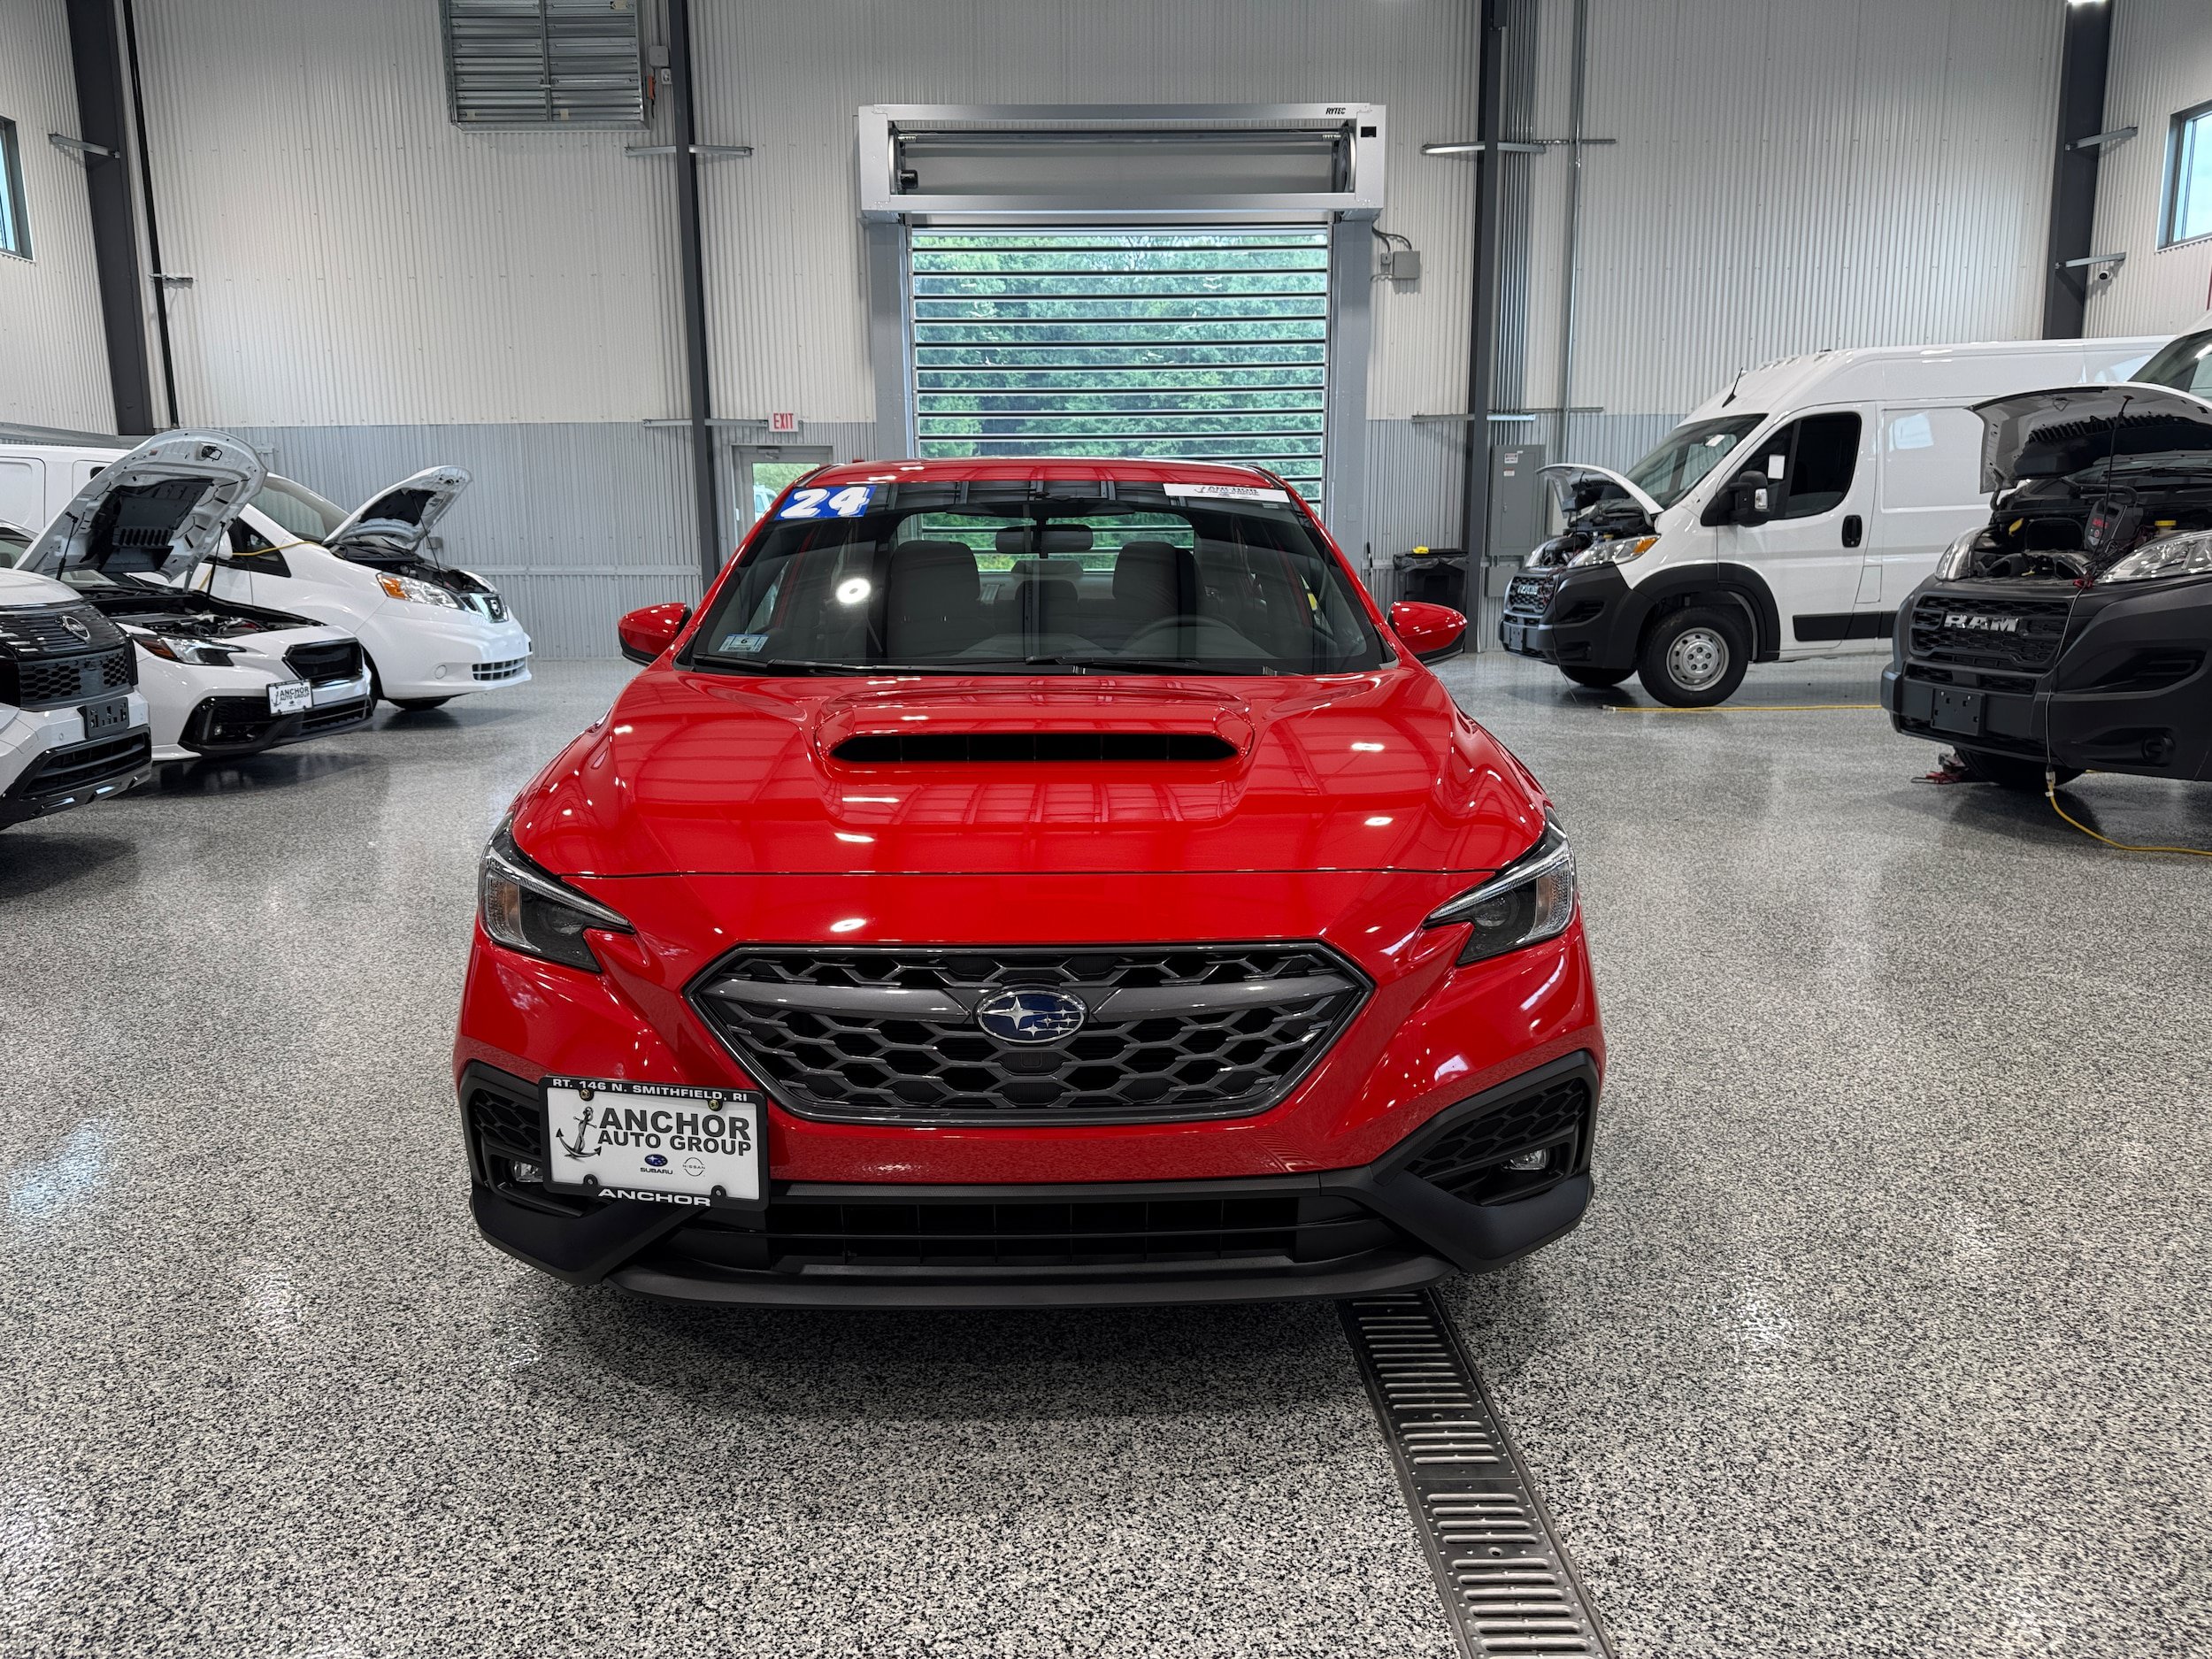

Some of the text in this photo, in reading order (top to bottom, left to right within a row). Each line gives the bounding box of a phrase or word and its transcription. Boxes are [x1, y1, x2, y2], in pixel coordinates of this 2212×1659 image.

[773, 412, 794, 429] EXIT
[780, 487, 870, 518] 24
[1944, 614, 2018, 632] RAM
[280, 686, 310, 696] ANCHOR
[552, 1079, 573, 1087] RT.
[580, 1081, 606, 1090] 146
[611, 1083, 627, 1092] N.
[733, 1093, 748, 1102] RI
[599, 1107, 751, 1141] ANCHOR
[597, 1130, 751, 1156] AUTO GROUP
[598, 1188, 710, 1206] ANCHOR
